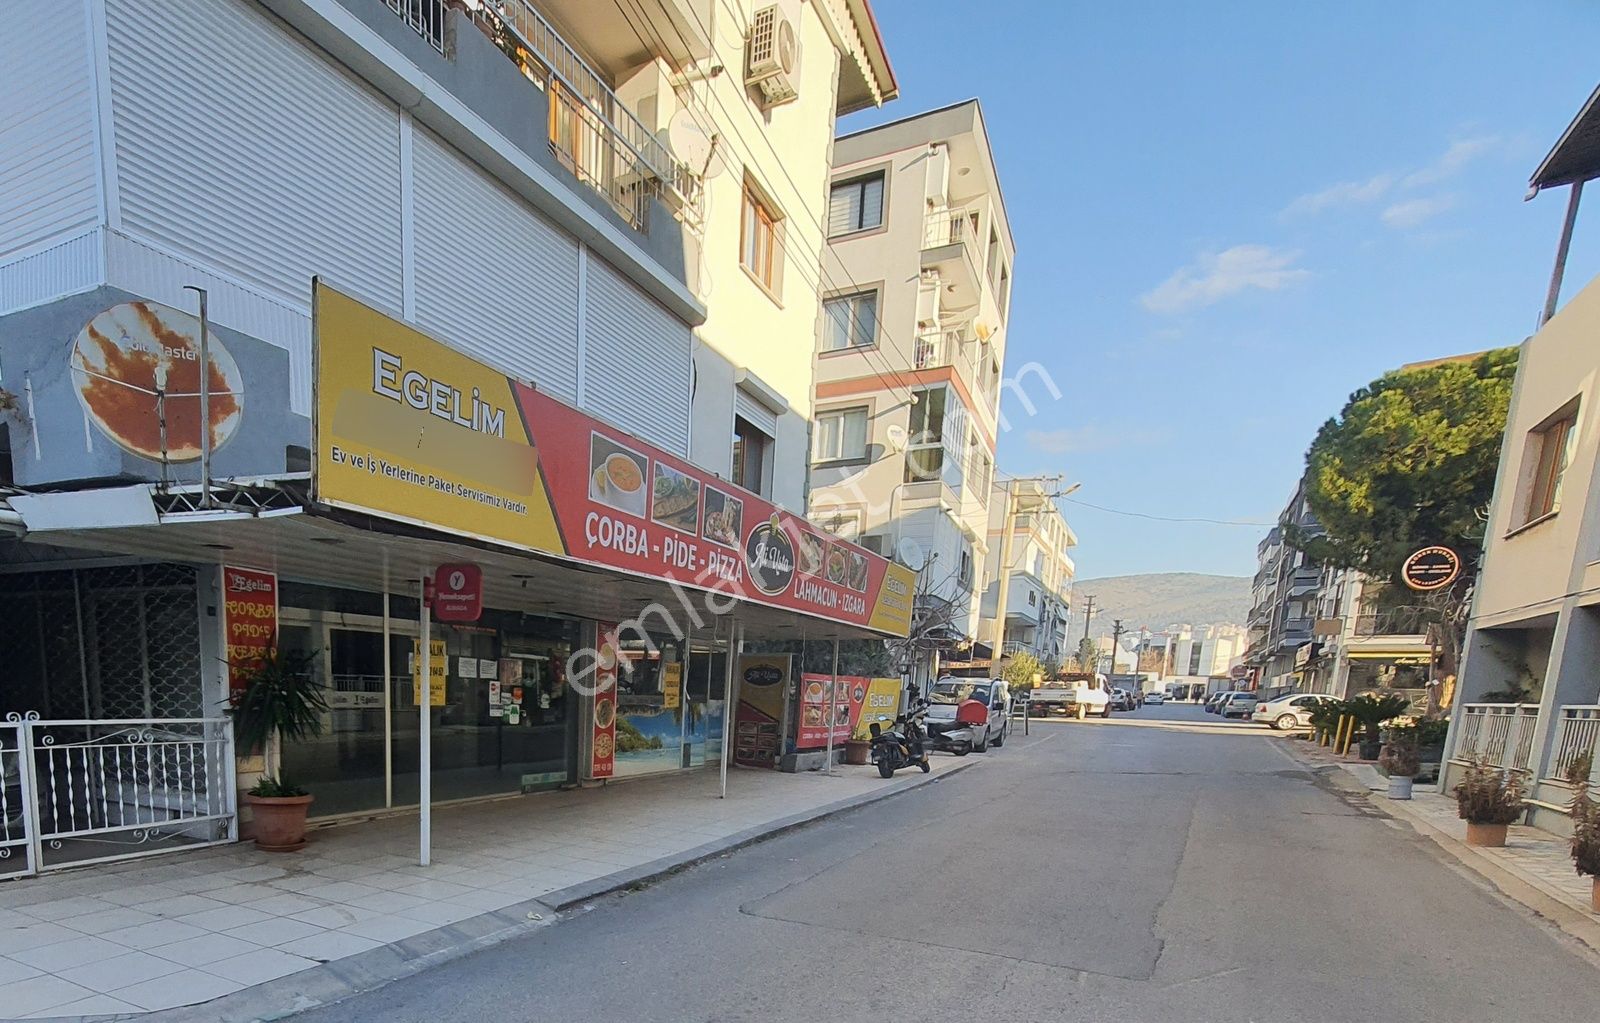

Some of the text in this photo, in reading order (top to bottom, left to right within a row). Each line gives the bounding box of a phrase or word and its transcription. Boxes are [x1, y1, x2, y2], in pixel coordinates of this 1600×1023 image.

[372, 347, 505, 439] EGELİM
[331, 446, 529, 516] Ev ve İş Yerlerine Paket Servisimiz Vardır.
[585, 511, 649, 559] ÇORBA
[663, 533, 698, 571] PİDE
[708, 548, 744, 584] PİZZA
[793, 577, 838, 609] LAHMACUN
